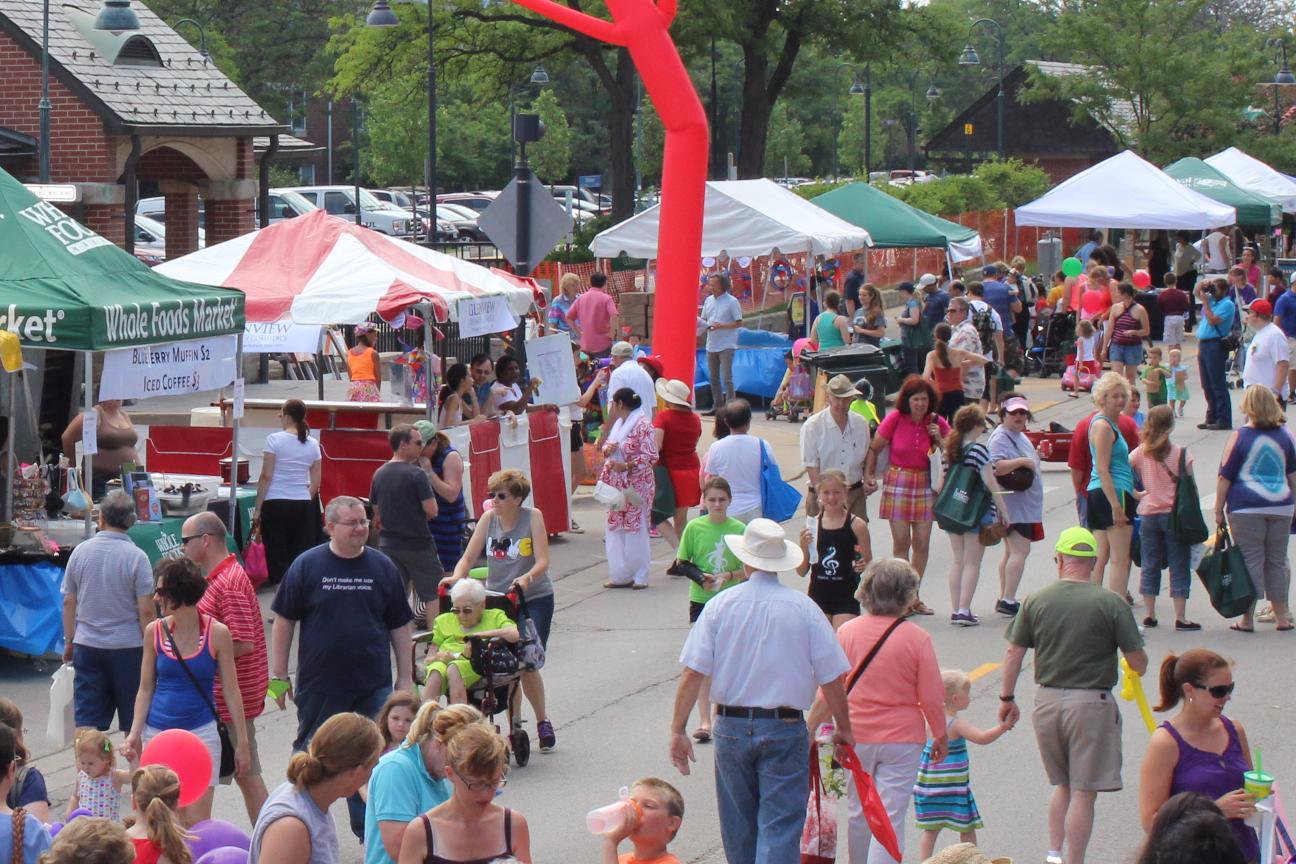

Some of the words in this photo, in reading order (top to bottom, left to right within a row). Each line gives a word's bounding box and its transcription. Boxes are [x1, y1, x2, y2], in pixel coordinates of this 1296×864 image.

[105, 302, 149, 343] Whole
[151, 298, 189, 337] Foods
[192, 297, 238, 332] Market
[201, 343, 211, 361] $2
